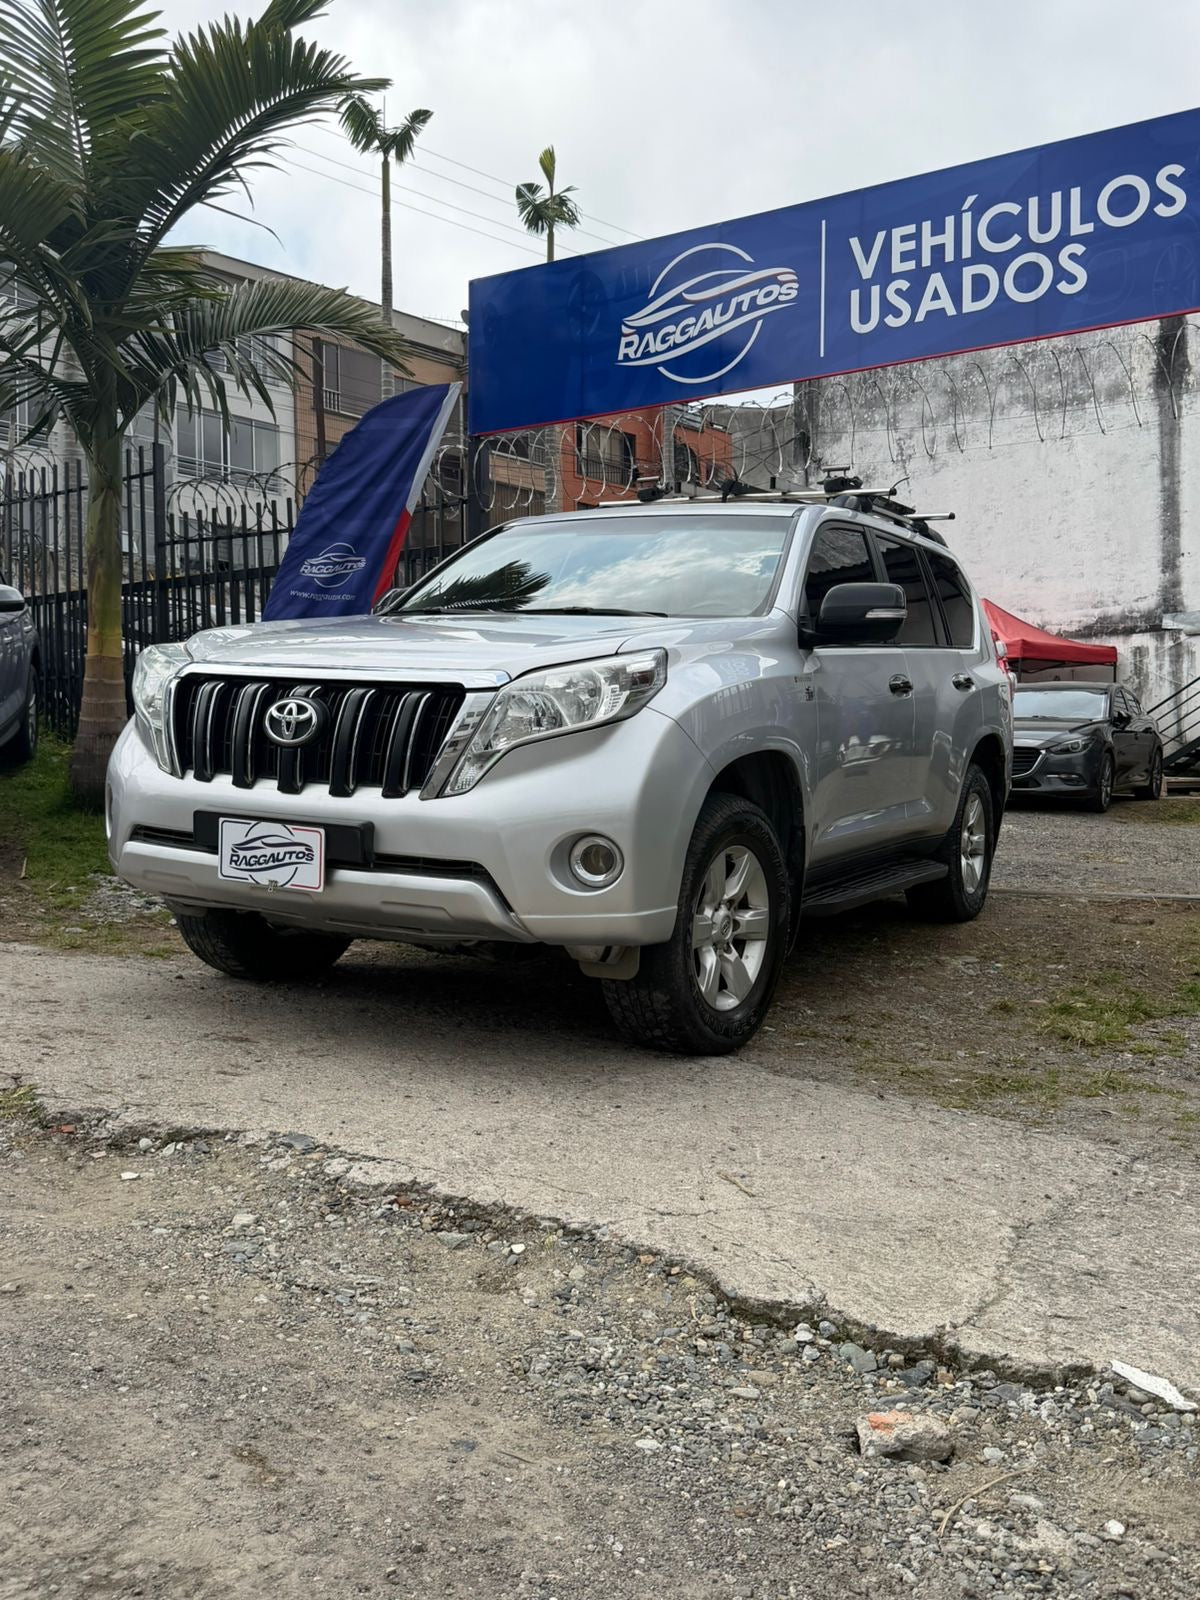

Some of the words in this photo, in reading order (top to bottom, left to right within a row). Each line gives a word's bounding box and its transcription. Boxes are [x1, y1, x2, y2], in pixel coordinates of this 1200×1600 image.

[849, 163, 1187, 280] VEHÍCULOS
[617, 282, 800, 360] RAGGAUTOS
[850, 243, 1088, 334] USADOS
[300, 561, 367, 574] RAGGAUTOS
[229, 850, 315, 867] RAGGAUTOS
